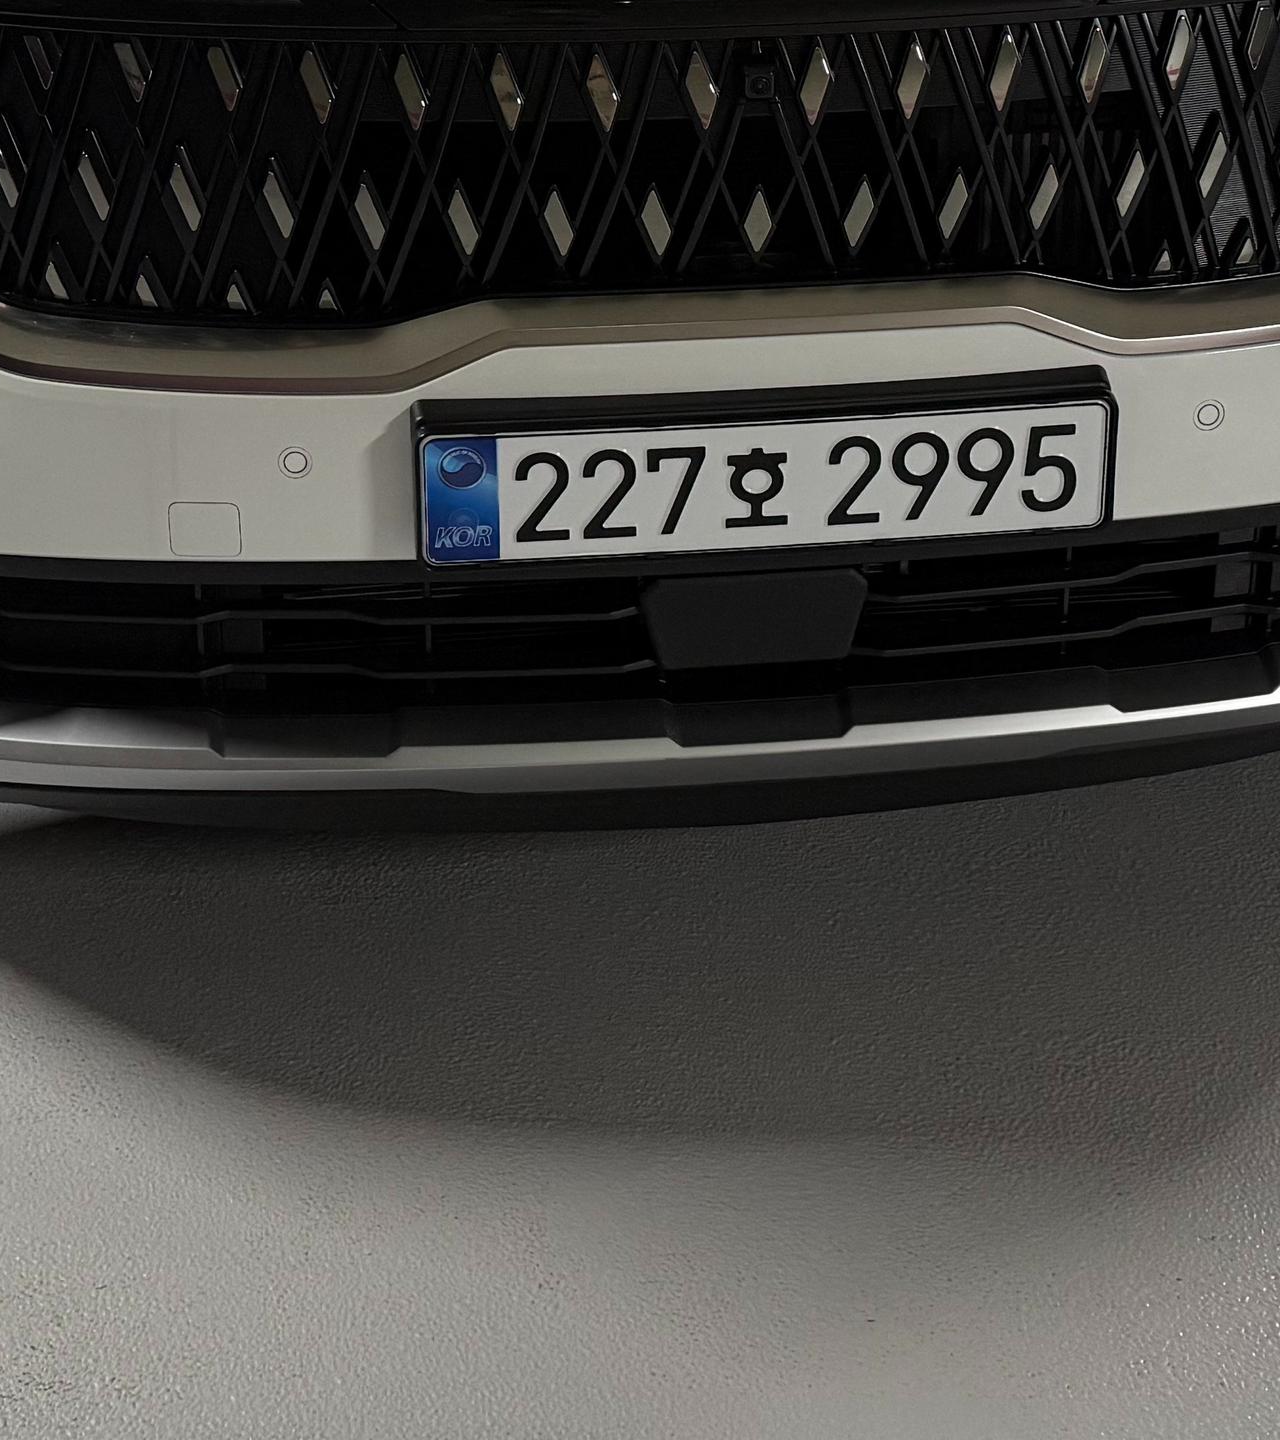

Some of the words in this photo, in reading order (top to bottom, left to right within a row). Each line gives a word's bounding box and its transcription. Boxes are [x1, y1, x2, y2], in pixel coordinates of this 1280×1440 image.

[513, 445, 789, 543] 227호
[826, 423, 1078, 527] 2995
[434, 525, 493, 549] KOR
